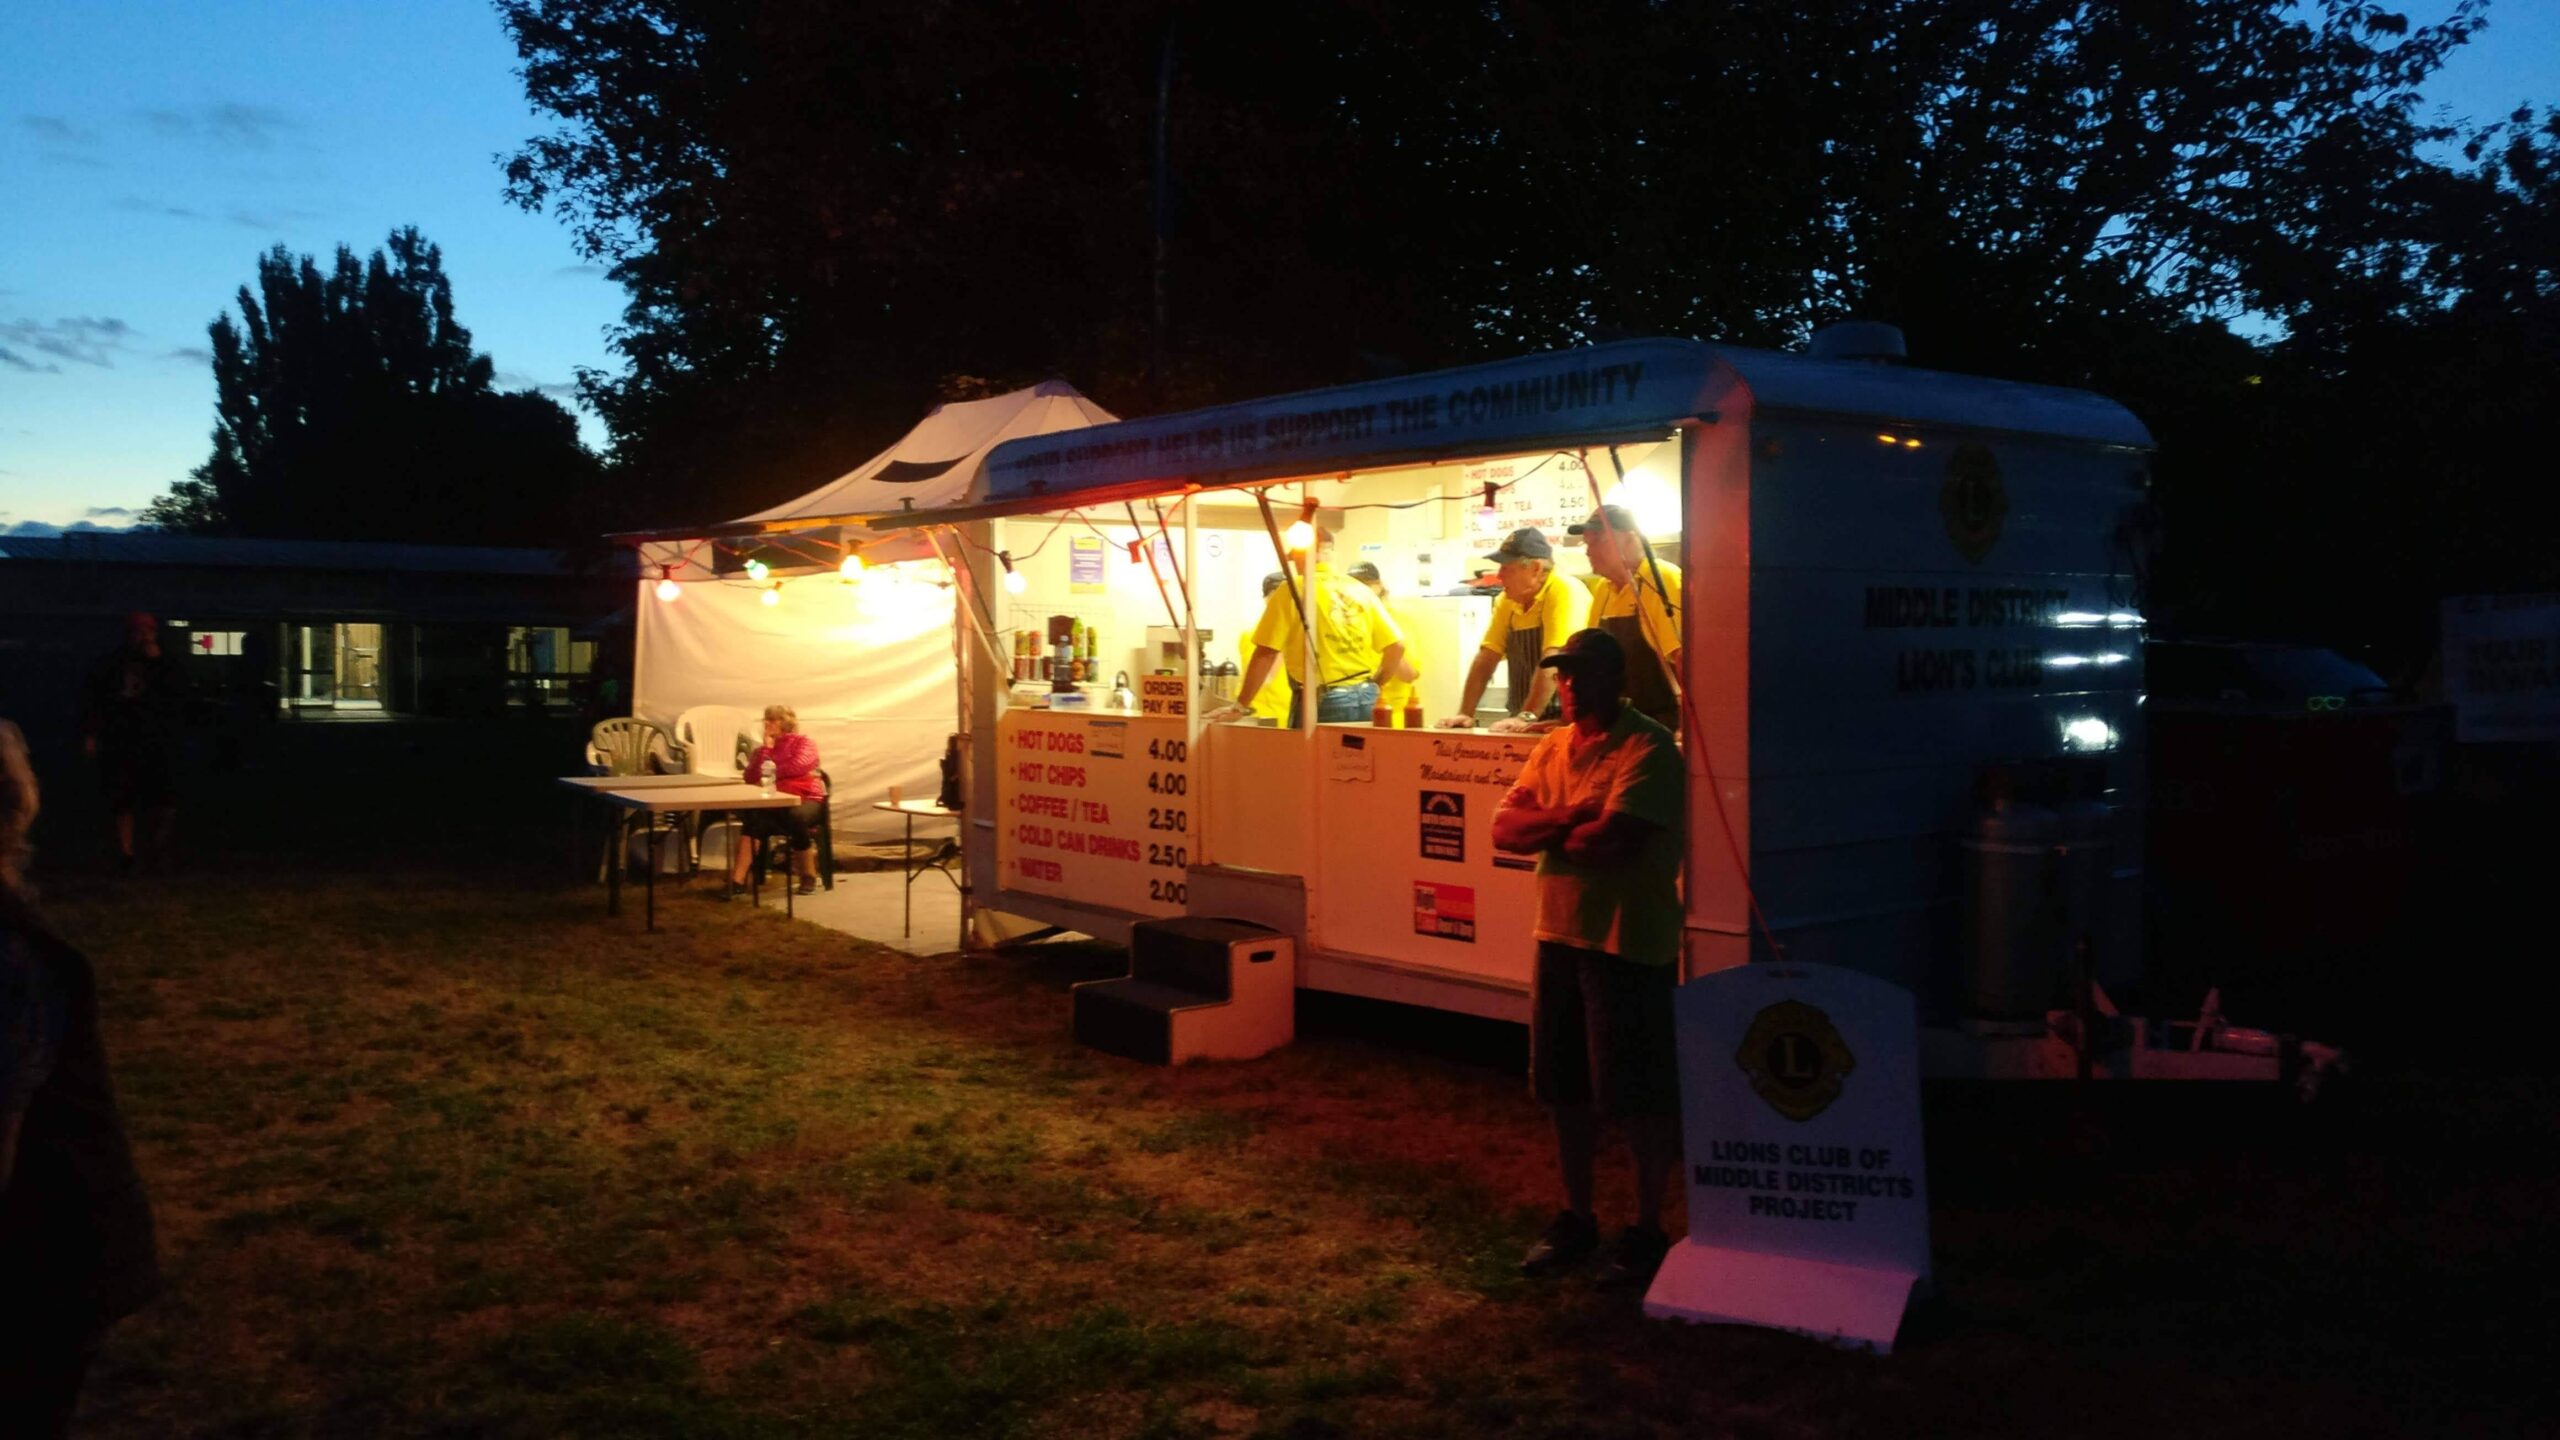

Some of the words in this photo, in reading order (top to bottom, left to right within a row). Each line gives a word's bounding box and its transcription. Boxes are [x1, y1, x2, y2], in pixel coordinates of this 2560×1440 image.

[1158, 426, 1223, 461] HELPS
[1230, 420, 1259, 452] US
[1265, 406, 1375, 450] SUPPORT
[1386, 395, 1438, 434] THE
[1447, 362, 1645, 426] COMMUNITY
[1515, 501, 1532, 512] TEA
[1865, 587, 1958, 627] MIDDLE
[1986, 649, 2043, 688] CLUB
[1144, 680, 1184, 696] ORDER
[1143, 700, 1163, 713] PAY
[1168, 700, 1186, 715] HE
[1017, 729, 1044, 750] HOT
[1047, 732, 1085, 754] DOGS
[1148, 738, 1187, 763] 4.00
[1017, 762, 1044, 784] HOT
[1049, 765, 1087, 788] CHIPS
[1148, 771, 1187, 796] 4.00
[1018, 793, 1069, 819] COFFEE
[1083, 801, 1110, 825] TEA
[1148, 808, 1187, 832] 2.50
[1018, 824, 1052, 847] COLD
[1056, 830, 1086, 854] CAN
[1088, 834, 1142, 863] DRINKS
[1148, 843, 1187, 869] 2.50
[1019, 857, 1063, 883] WATER
[1150, 879, 1188, 905] 2.00
[1711, 1141, 1781, 1163] LIONS
[1788, 1145, 1852, 1167] CLUB
[1859, 1149, 1892, 1170] OF
[1694, 1165, 1779, 1190] MIDDLE
[1788, 1172, 1914, 1199] DISTRICTS
[1749, 1196, 1858, 1222] PROJECT
